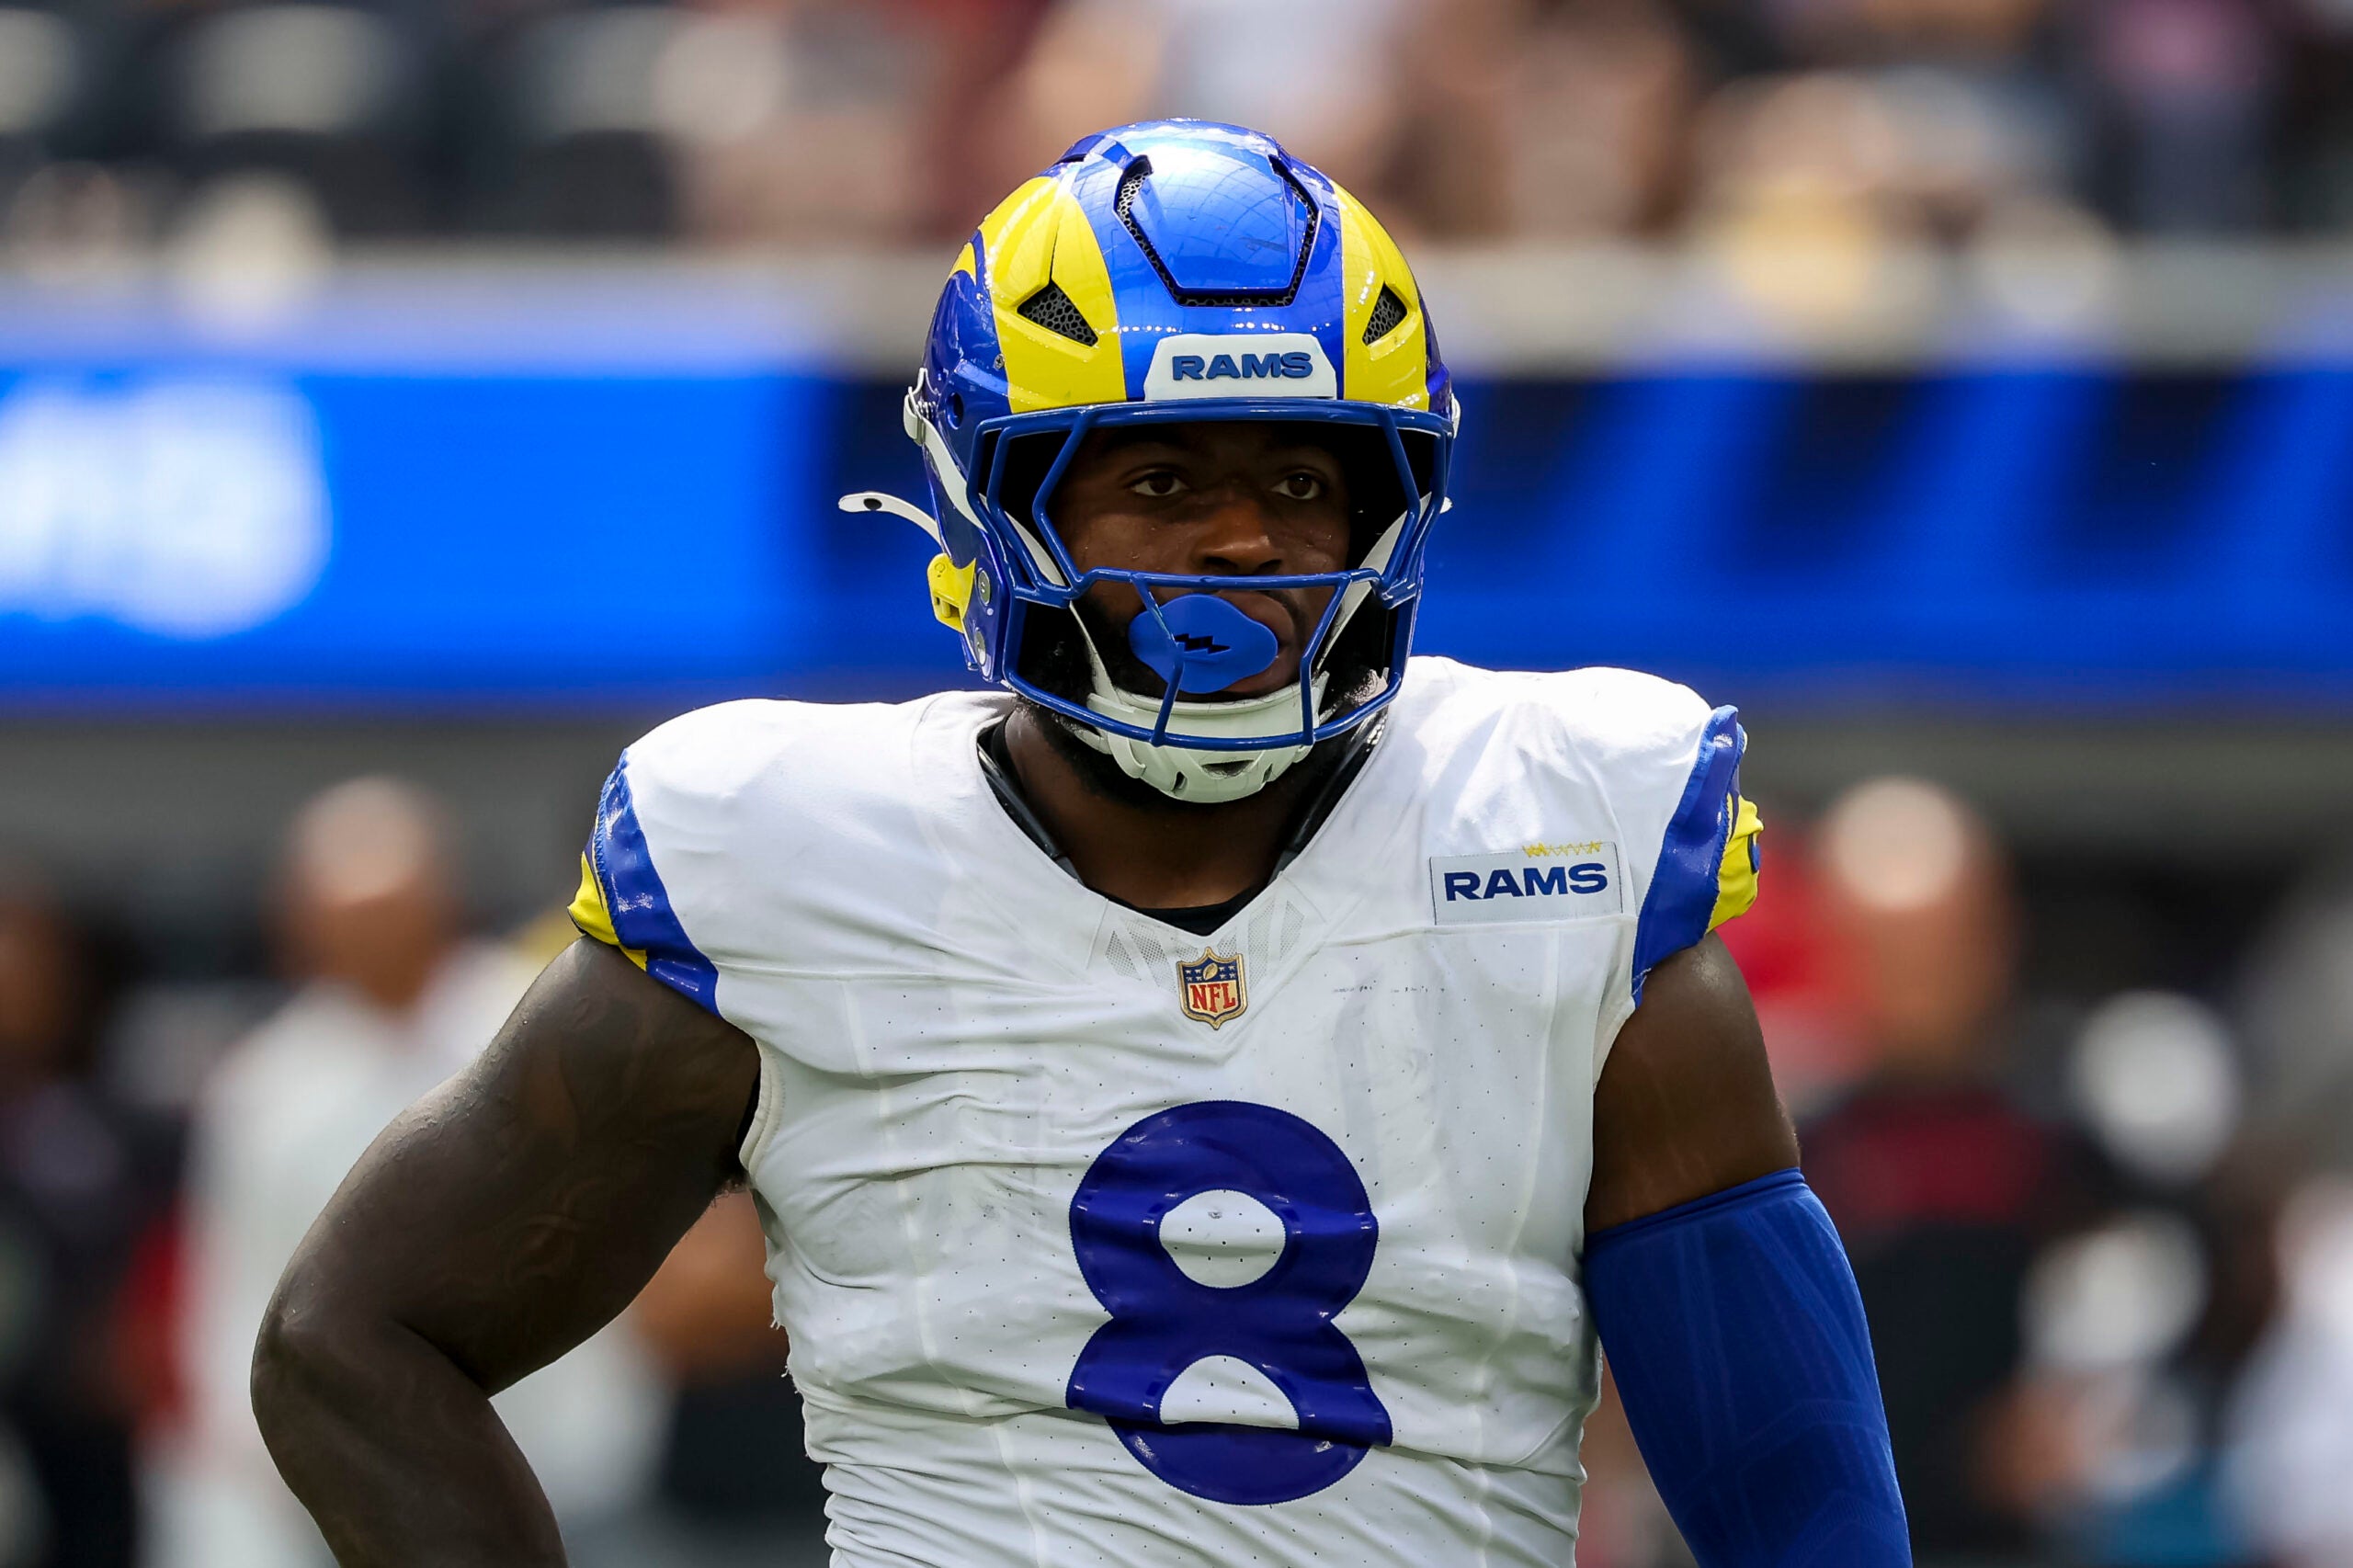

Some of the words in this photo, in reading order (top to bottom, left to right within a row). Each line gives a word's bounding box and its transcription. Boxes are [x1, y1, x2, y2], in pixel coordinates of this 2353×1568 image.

[1172, 352, 1313, 381] RAMS
[1444, 862, 1608, 902] RAMS
[1190, 983, 1236, 1013] NFL
[1066, 1100, 1393, 1506] 8
